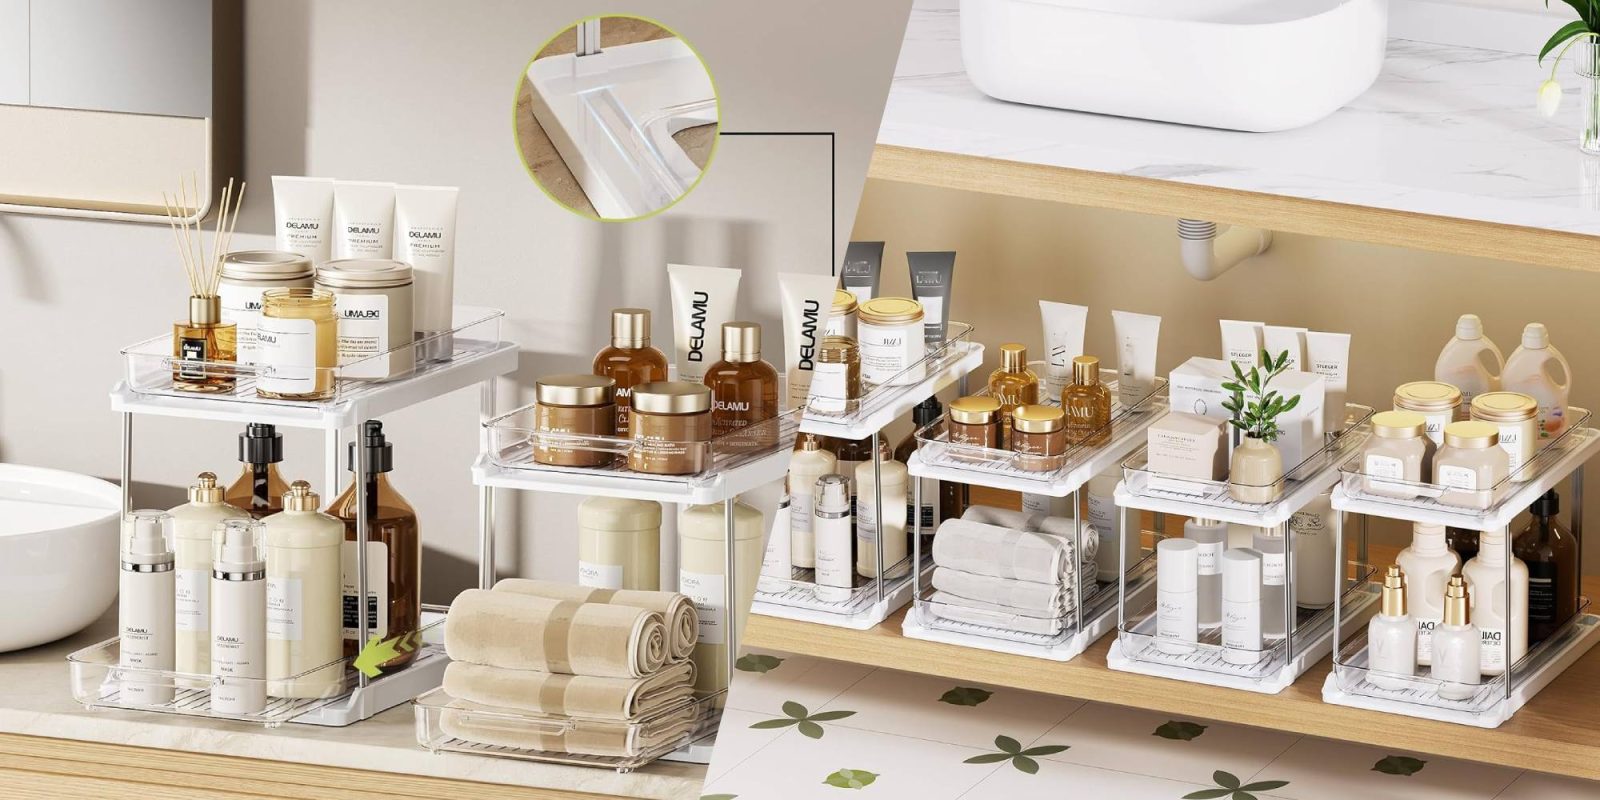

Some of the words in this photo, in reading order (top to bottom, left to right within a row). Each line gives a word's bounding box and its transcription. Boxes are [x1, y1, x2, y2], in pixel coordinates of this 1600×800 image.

[286, 221, 319, 230] DELAMU
[347, 226, 380, 234] DELAMU
[408, 230, 442, 239] DELAMU
[688, 291, 709, 362] DELAMU
[798, 299, 820, 371] DELAMU
[713, 401, 750, 412] DELAMU
